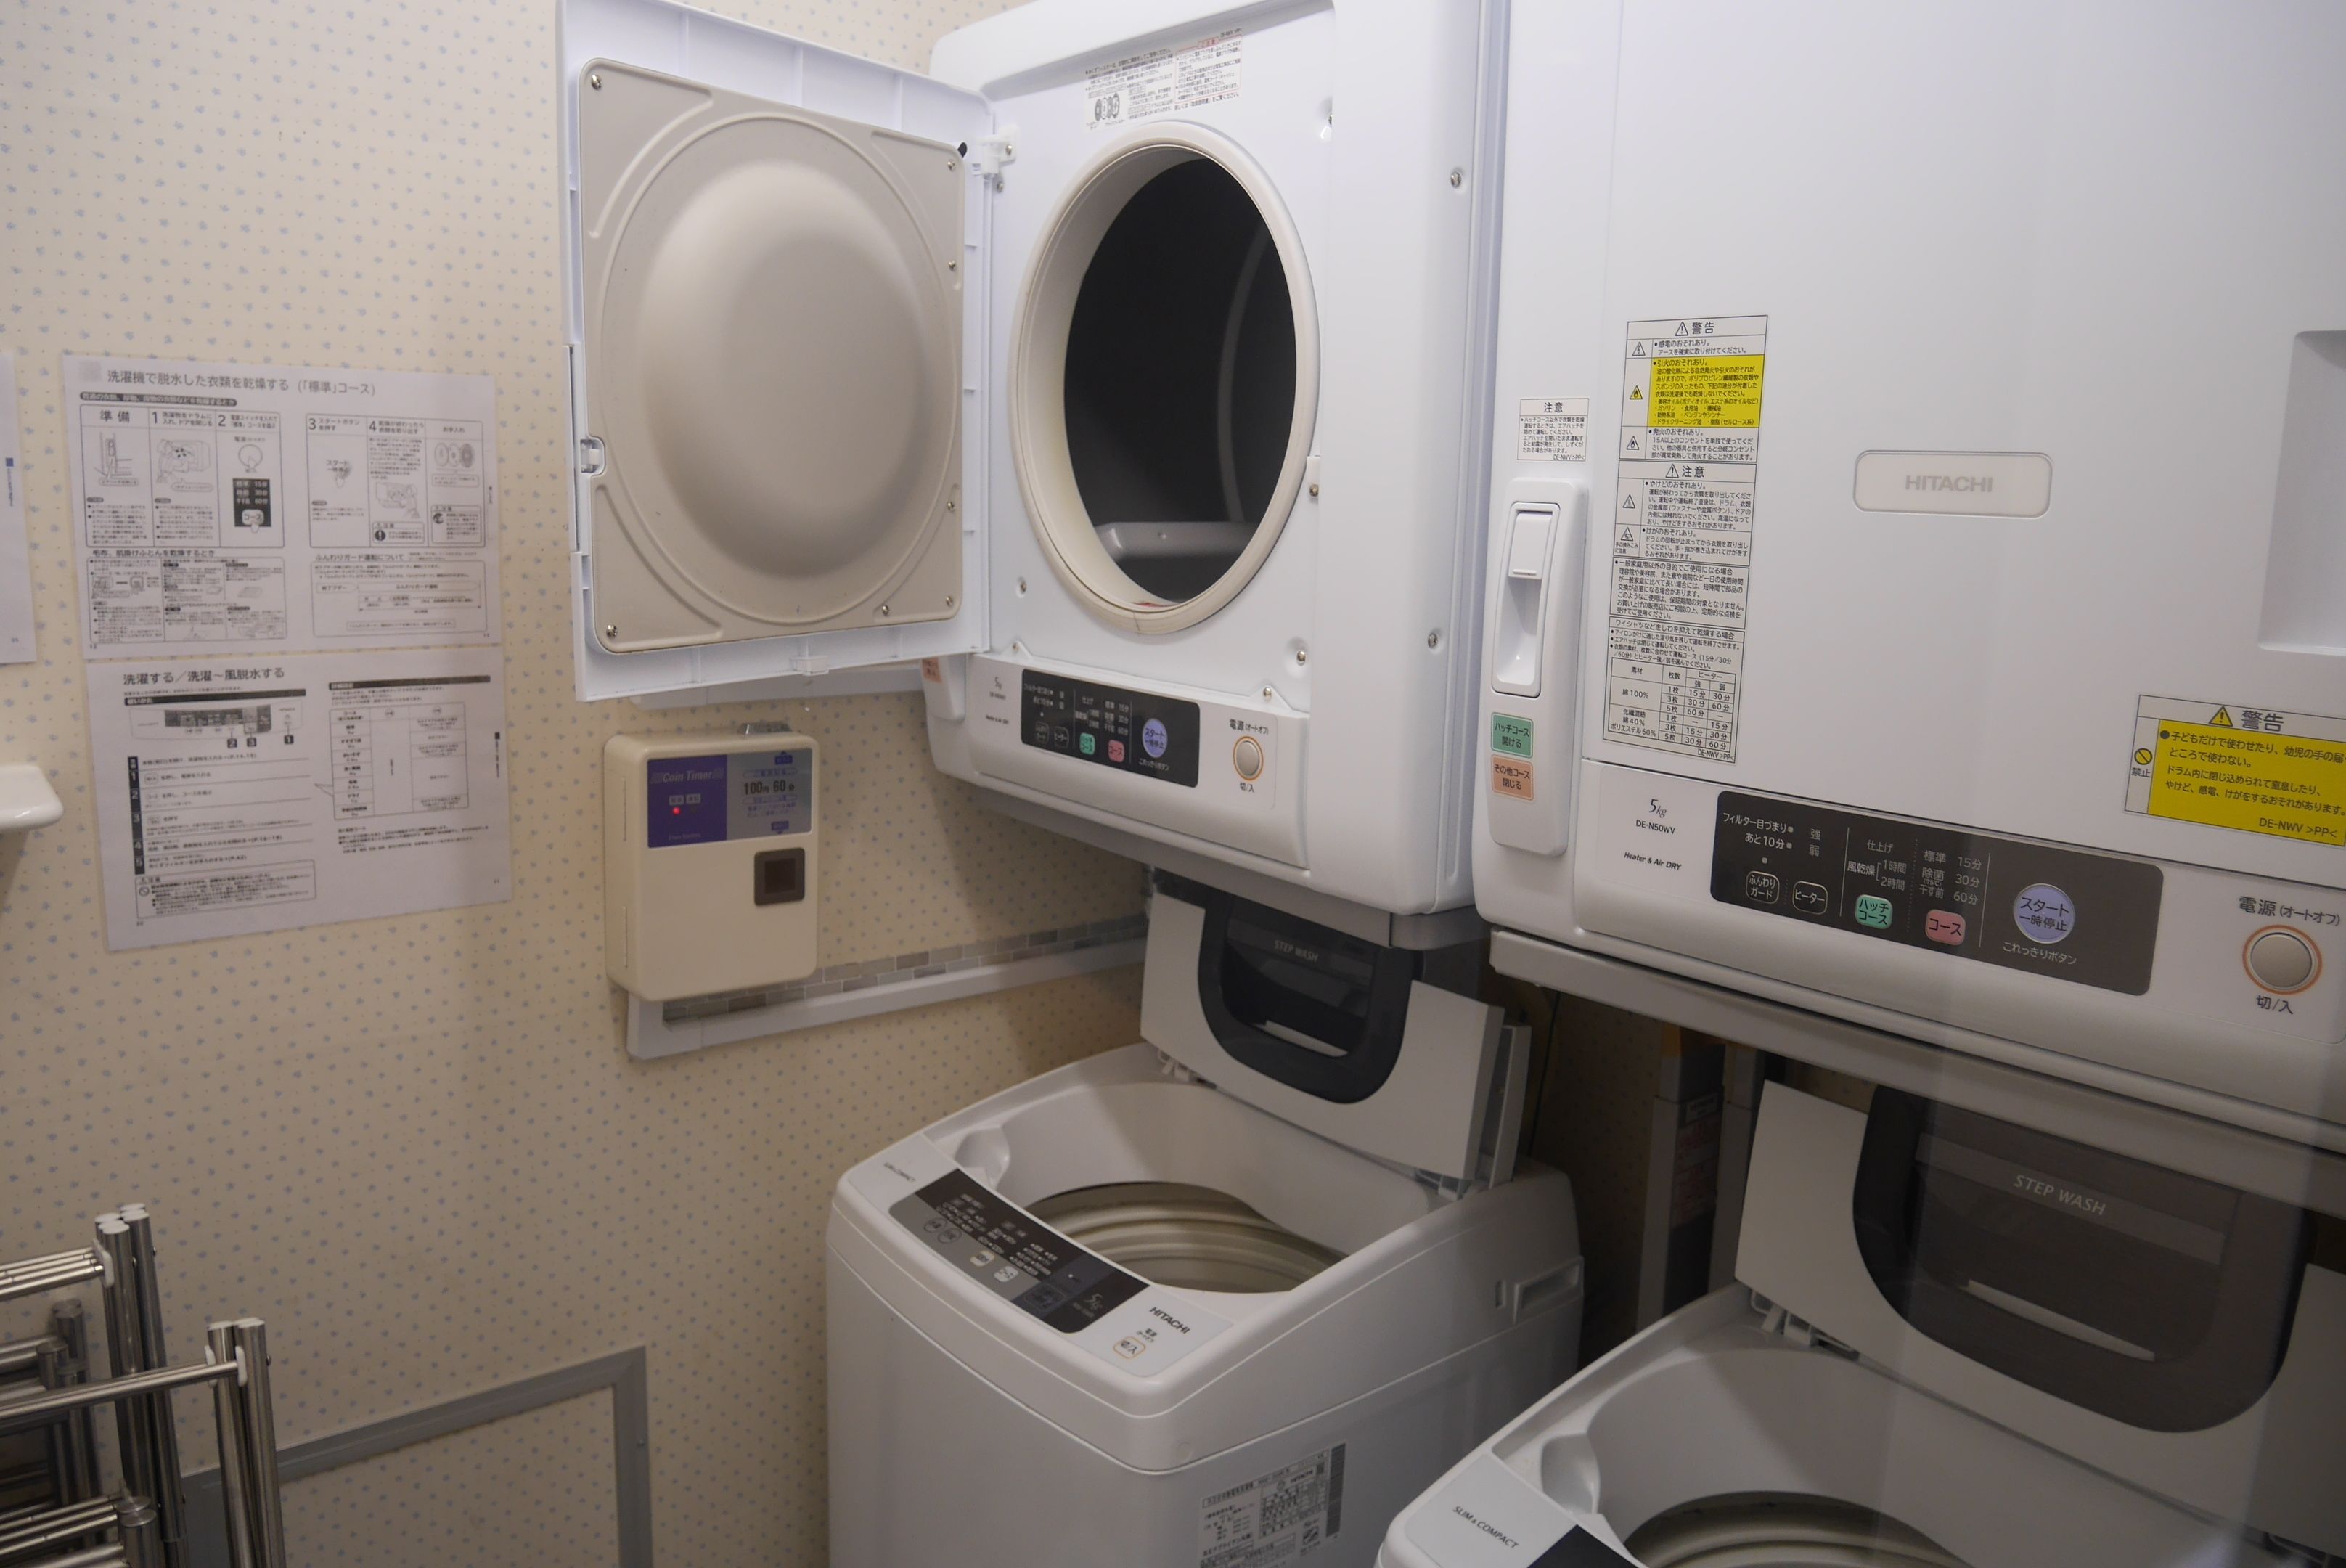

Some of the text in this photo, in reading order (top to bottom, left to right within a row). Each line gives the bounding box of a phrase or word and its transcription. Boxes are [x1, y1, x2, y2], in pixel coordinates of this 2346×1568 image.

[1692, 321, 1715, 335] 警告
[1658, 339, 1709, 348] 感電のおそれあり。
[1544, 401, 1563, 413] 注意
[99, 410, 131, 423] 準備
[152, 411, 158, 424] 1
[217, 414, 226, 427] 2
[308, 418, 316, 430] 3
[369, 420, 377, 432] 4
[1682, 465, 1705, 478] 注意
[1650, 481, 1706, 489] やけどのおそれあり。
[1904, 475, 1994, 493] HITACHI
[1646, 528, 1696, 537] けがのおそれあり。
[1699, 671, 1723, 679] ヒーター
[2241, 709, 2285, 732] 警告
[1495, 722, 1529, 737] ハッチコース
[1502, 735, 1522, 748] 開ける
[2171, 730, 2346, 765] 子どもだけで使わせたり、幼児の手の届
[2169, 747, 2252, 768] ところで使わない。
[1494, 764, 1530, 780] その他コース
[2130, 767, 2151, 778] 禁止
[1503, 777, 1522, 790] 閉じる
[1635, 820, 1676, 835] DE-N50WV
[1722, 813, 1788, 833] フィルター目づまり
[2259, 817, 2303, 833] DE-NWV
[1744, 833, 1786, 850] あと10分
[1810, 828, 1821, 841] 強
[1809, 844, 1820, 857] 弱
[1867, 839, 1894, 854] 仕上げ
[1624, 852, 1646, 863] Heater
[1666, 861, 1683, 870] DRY
[1847, 859, 1907, 877] 風乾燥 1時間
[1924, 850, 1982, 871] 標準 15分
[1749, 875, 1776, 888] ふんわり
[1881, 876, 1905, 891] 2時間
[1922, 867, 1980, 889] 除菌 30分
[1750, 887, 1773, 900] ガード
[1794, 889, 1825, 905] ヒーター
[1918, 883, 1979, 905] 干す前 60分
[1858, 898, 1889, 913] ハッチ
[2020, 897, 2070, 917] スタート
[1858, 912, 1888, 926] コース
[2019, 913, 2068, 932] 一時停止
[1928, 918, 1963, 936] コース
[1274, 939, 1294, 953] STEP
[2003, 942, 2077, 965] これっきりボタン
[2014, 1174, 2106, 1216] STEP WASH
[1149, 1306, 1191, 1334] HITACHI
[1452, 1506, 1474, 1522] SLIM
[1476, 1520, 1519, 1550] COMPACT
